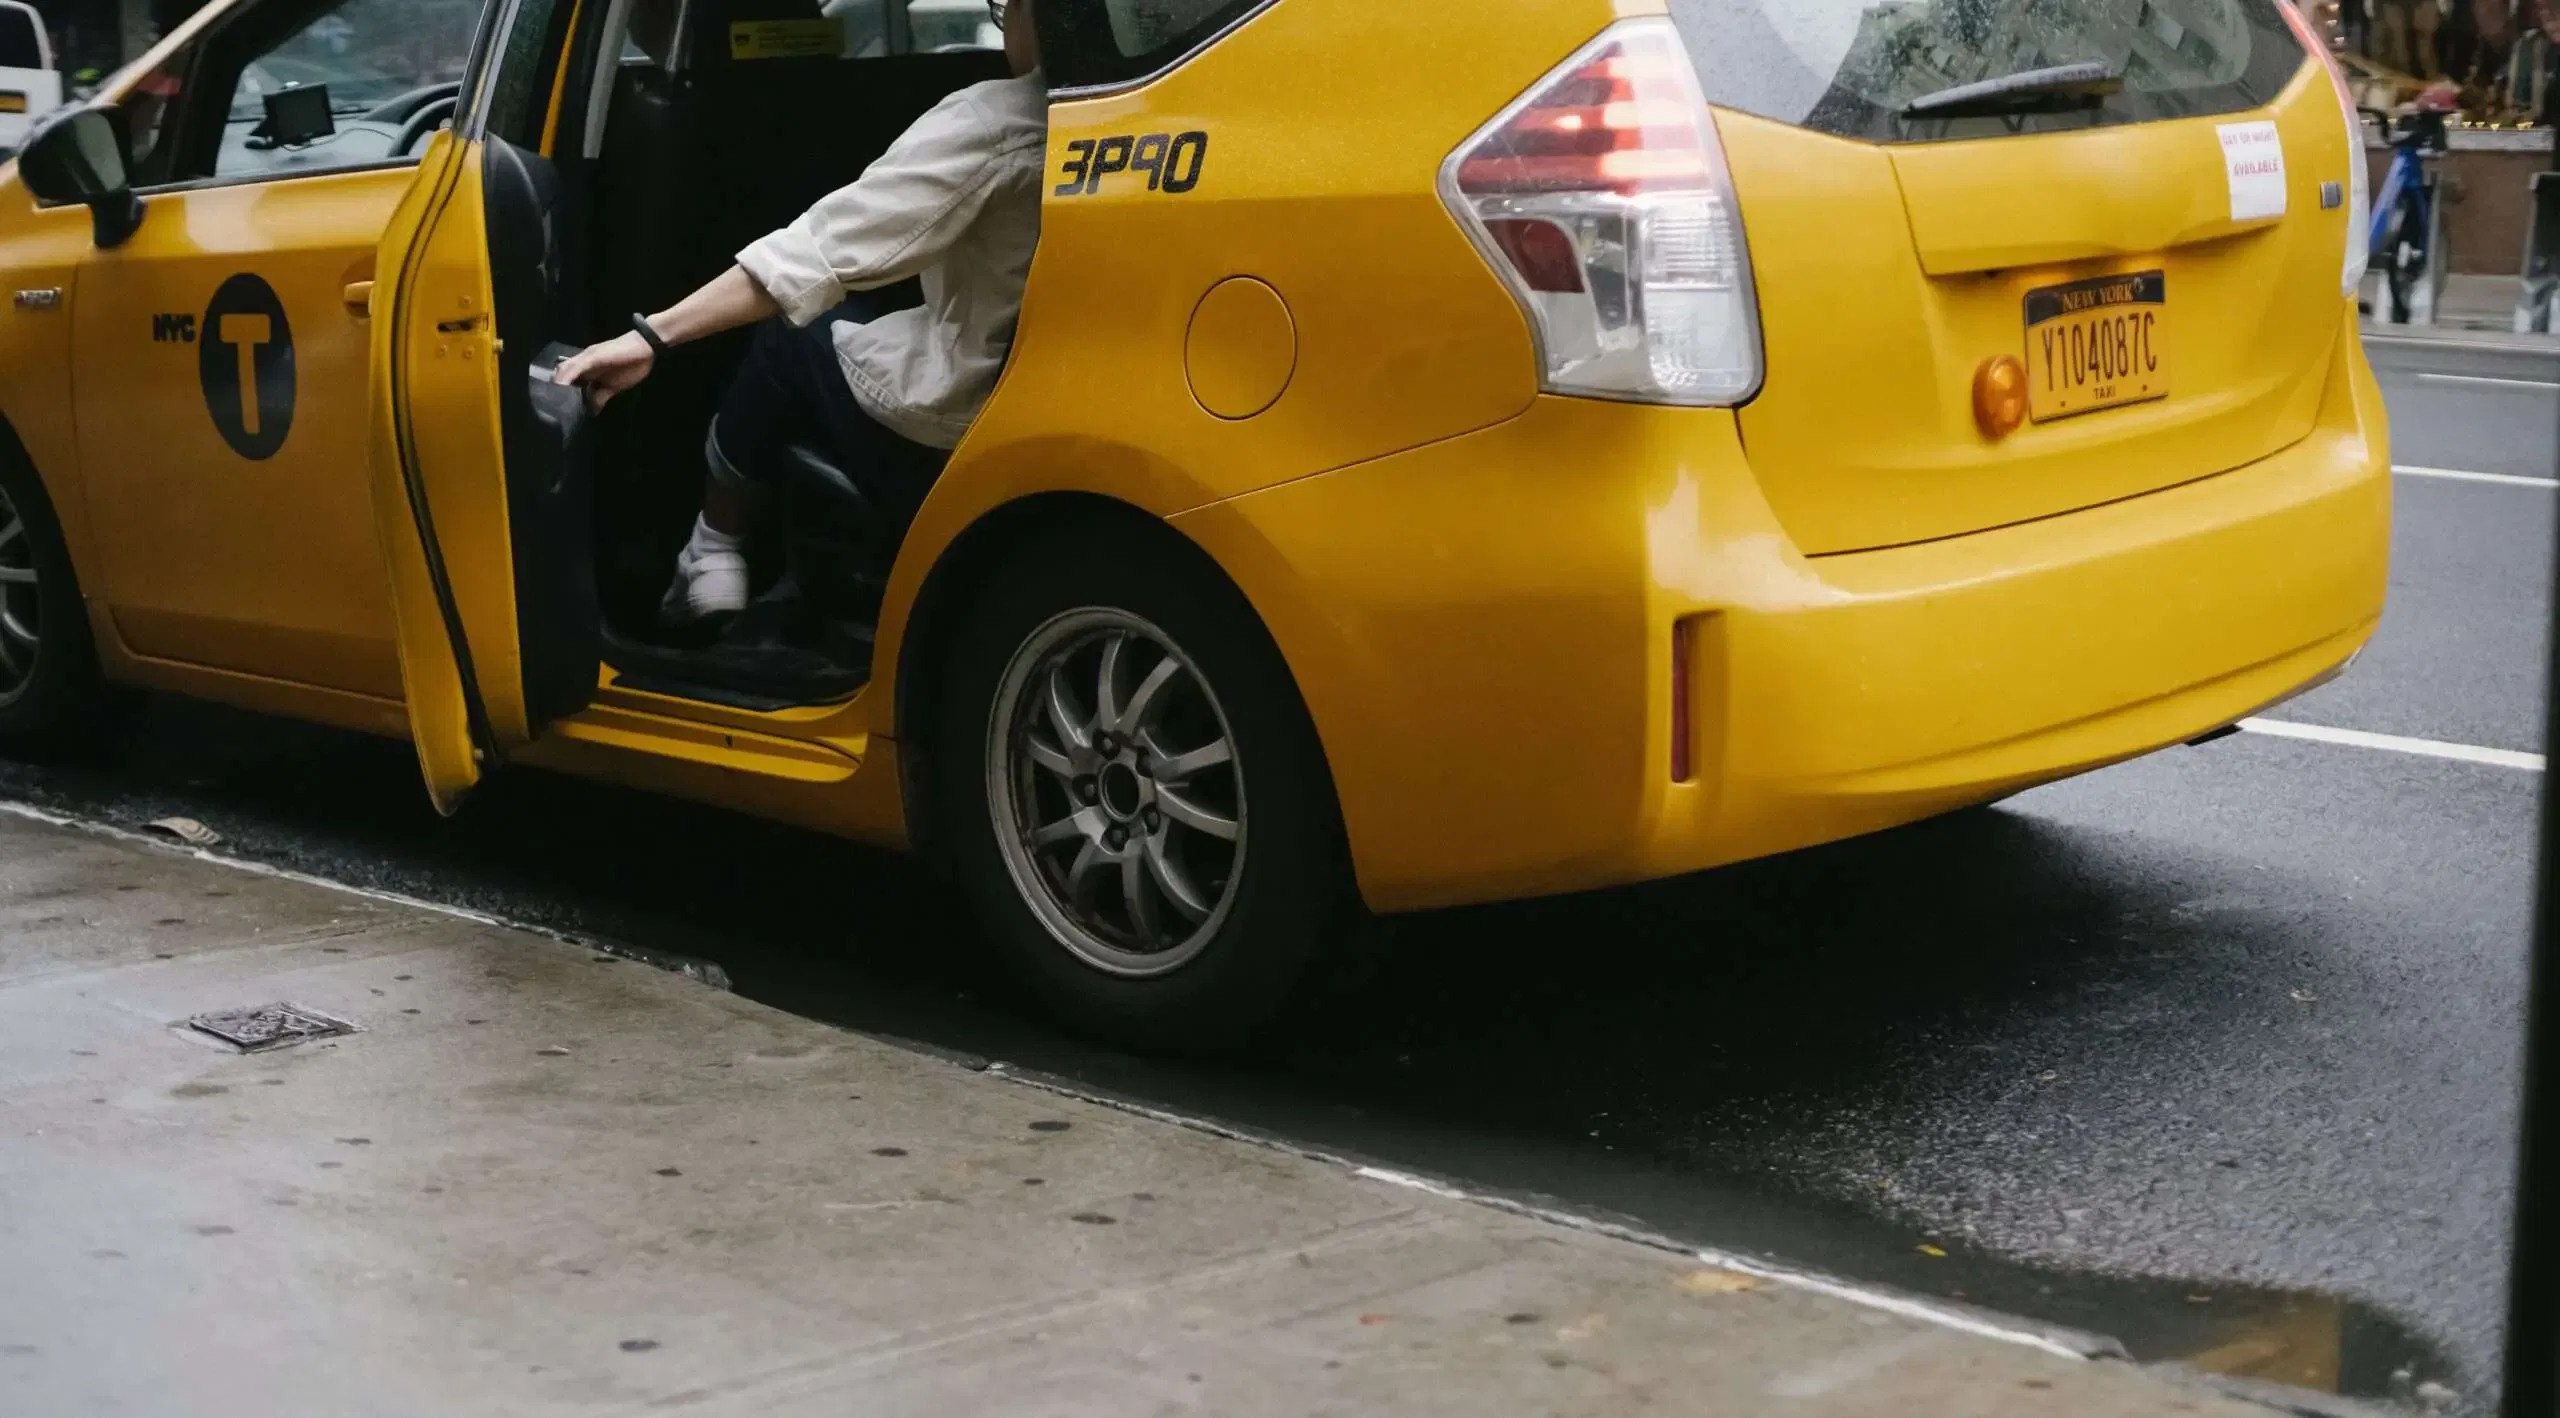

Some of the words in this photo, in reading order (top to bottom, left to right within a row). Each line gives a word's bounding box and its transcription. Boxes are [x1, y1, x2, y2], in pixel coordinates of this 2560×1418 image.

[1055, 131, 1208, 196] 3P90
[2062, 289, 2096, 312] NEW
[2099, 283, 2134, 304] YORK
[153, 313, 196, 343] NYC
[220, 313, 271, 434] T
[2042, 311, 2157, 392] Y104087C
[2093, 385, 2117, 399] TAXI
